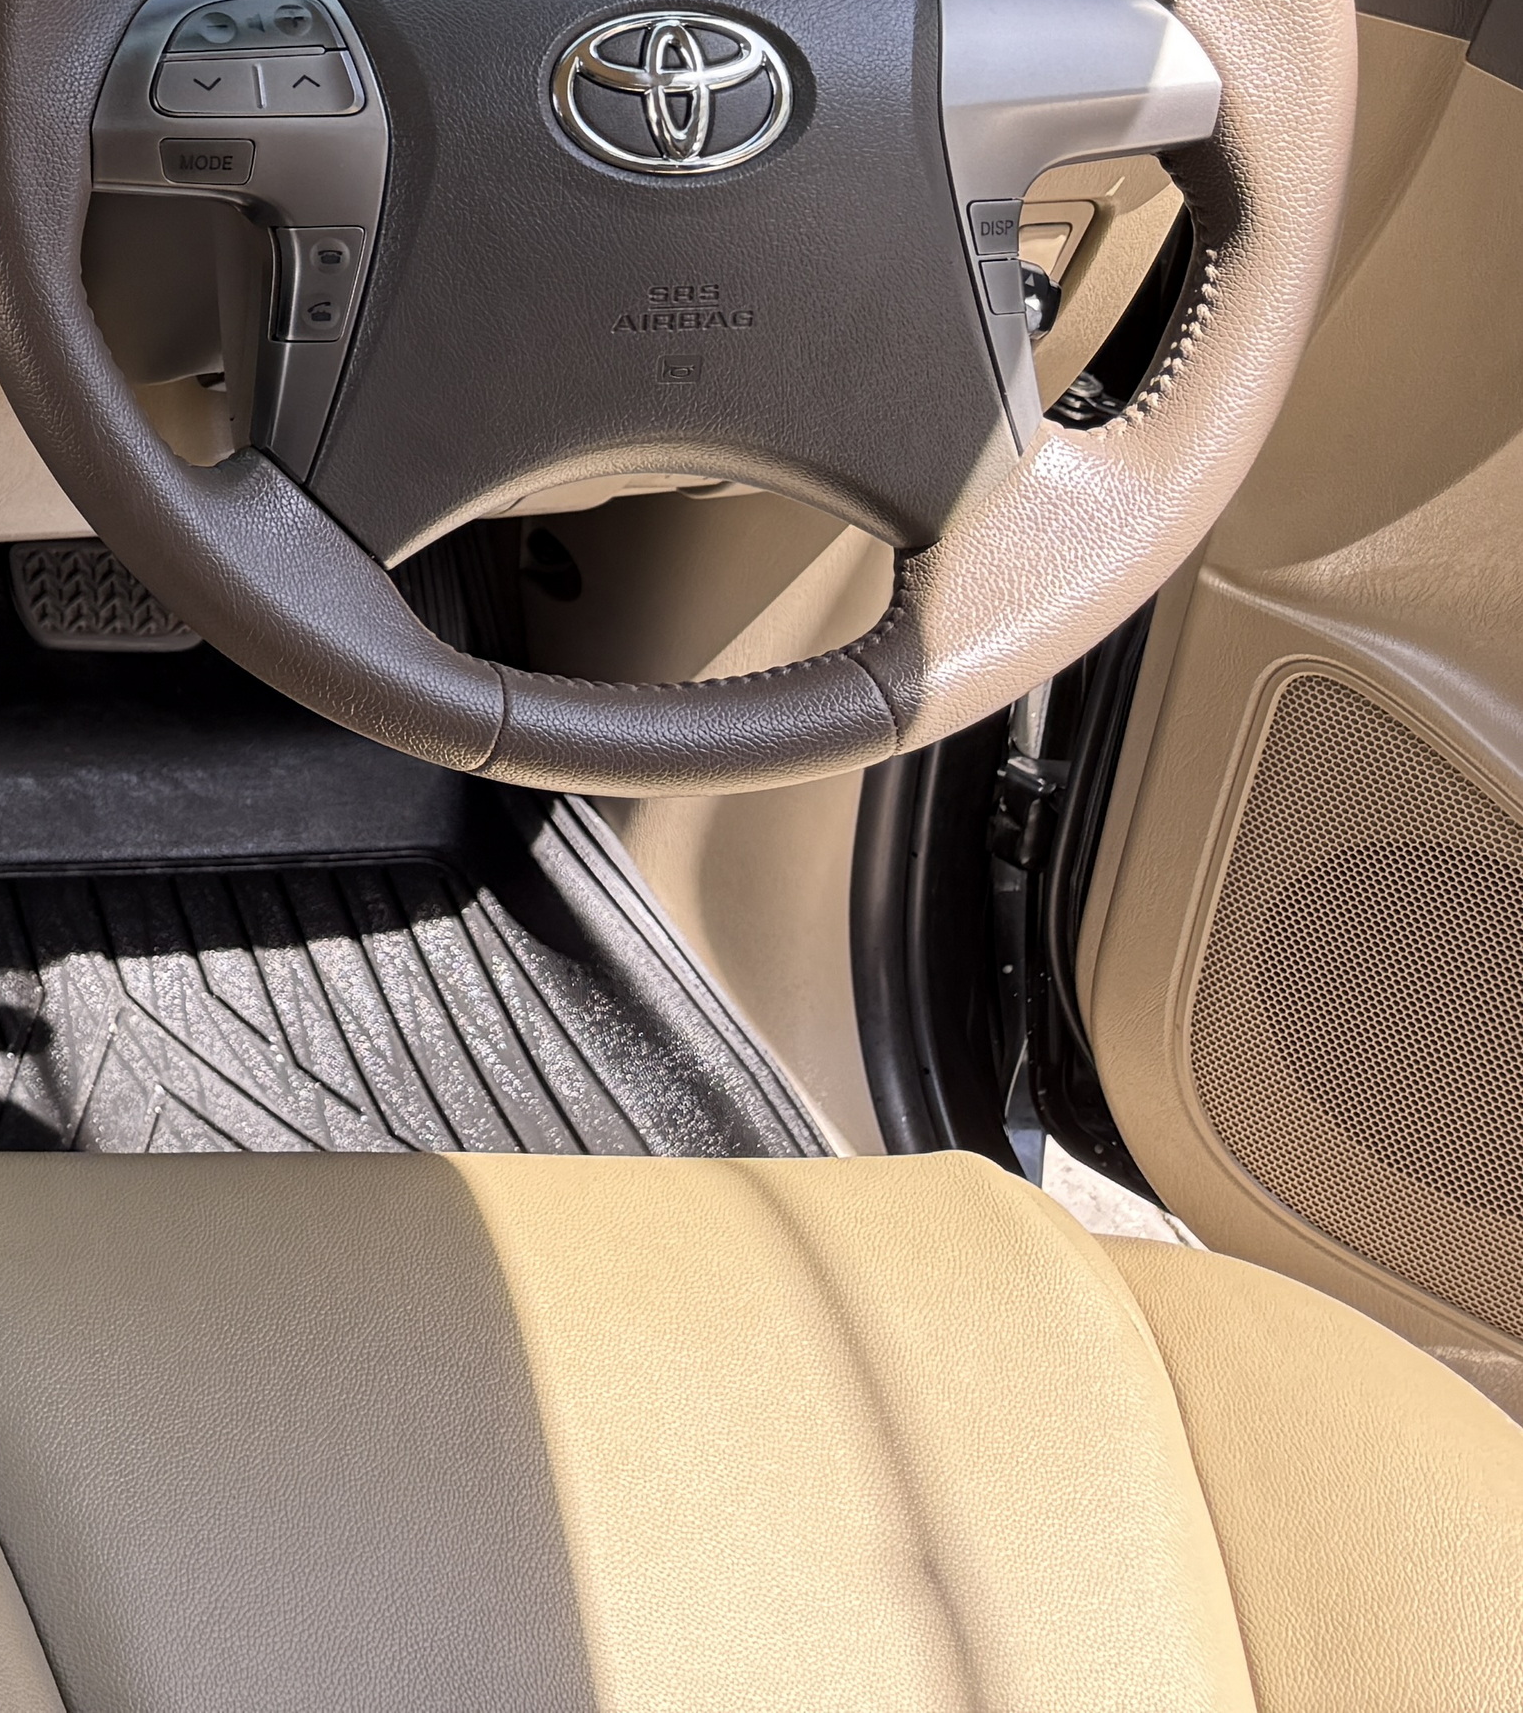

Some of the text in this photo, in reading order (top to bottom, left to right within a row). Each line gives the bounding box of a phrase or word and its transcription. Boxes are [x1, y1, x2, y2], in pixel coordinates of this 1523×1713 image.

[179, 153, 234, 172] MODE
[979, 218, 1015, 238] DISP
[648, 284, 719, 303] SRS
[611, 310, 753, 333] AIRBAG
